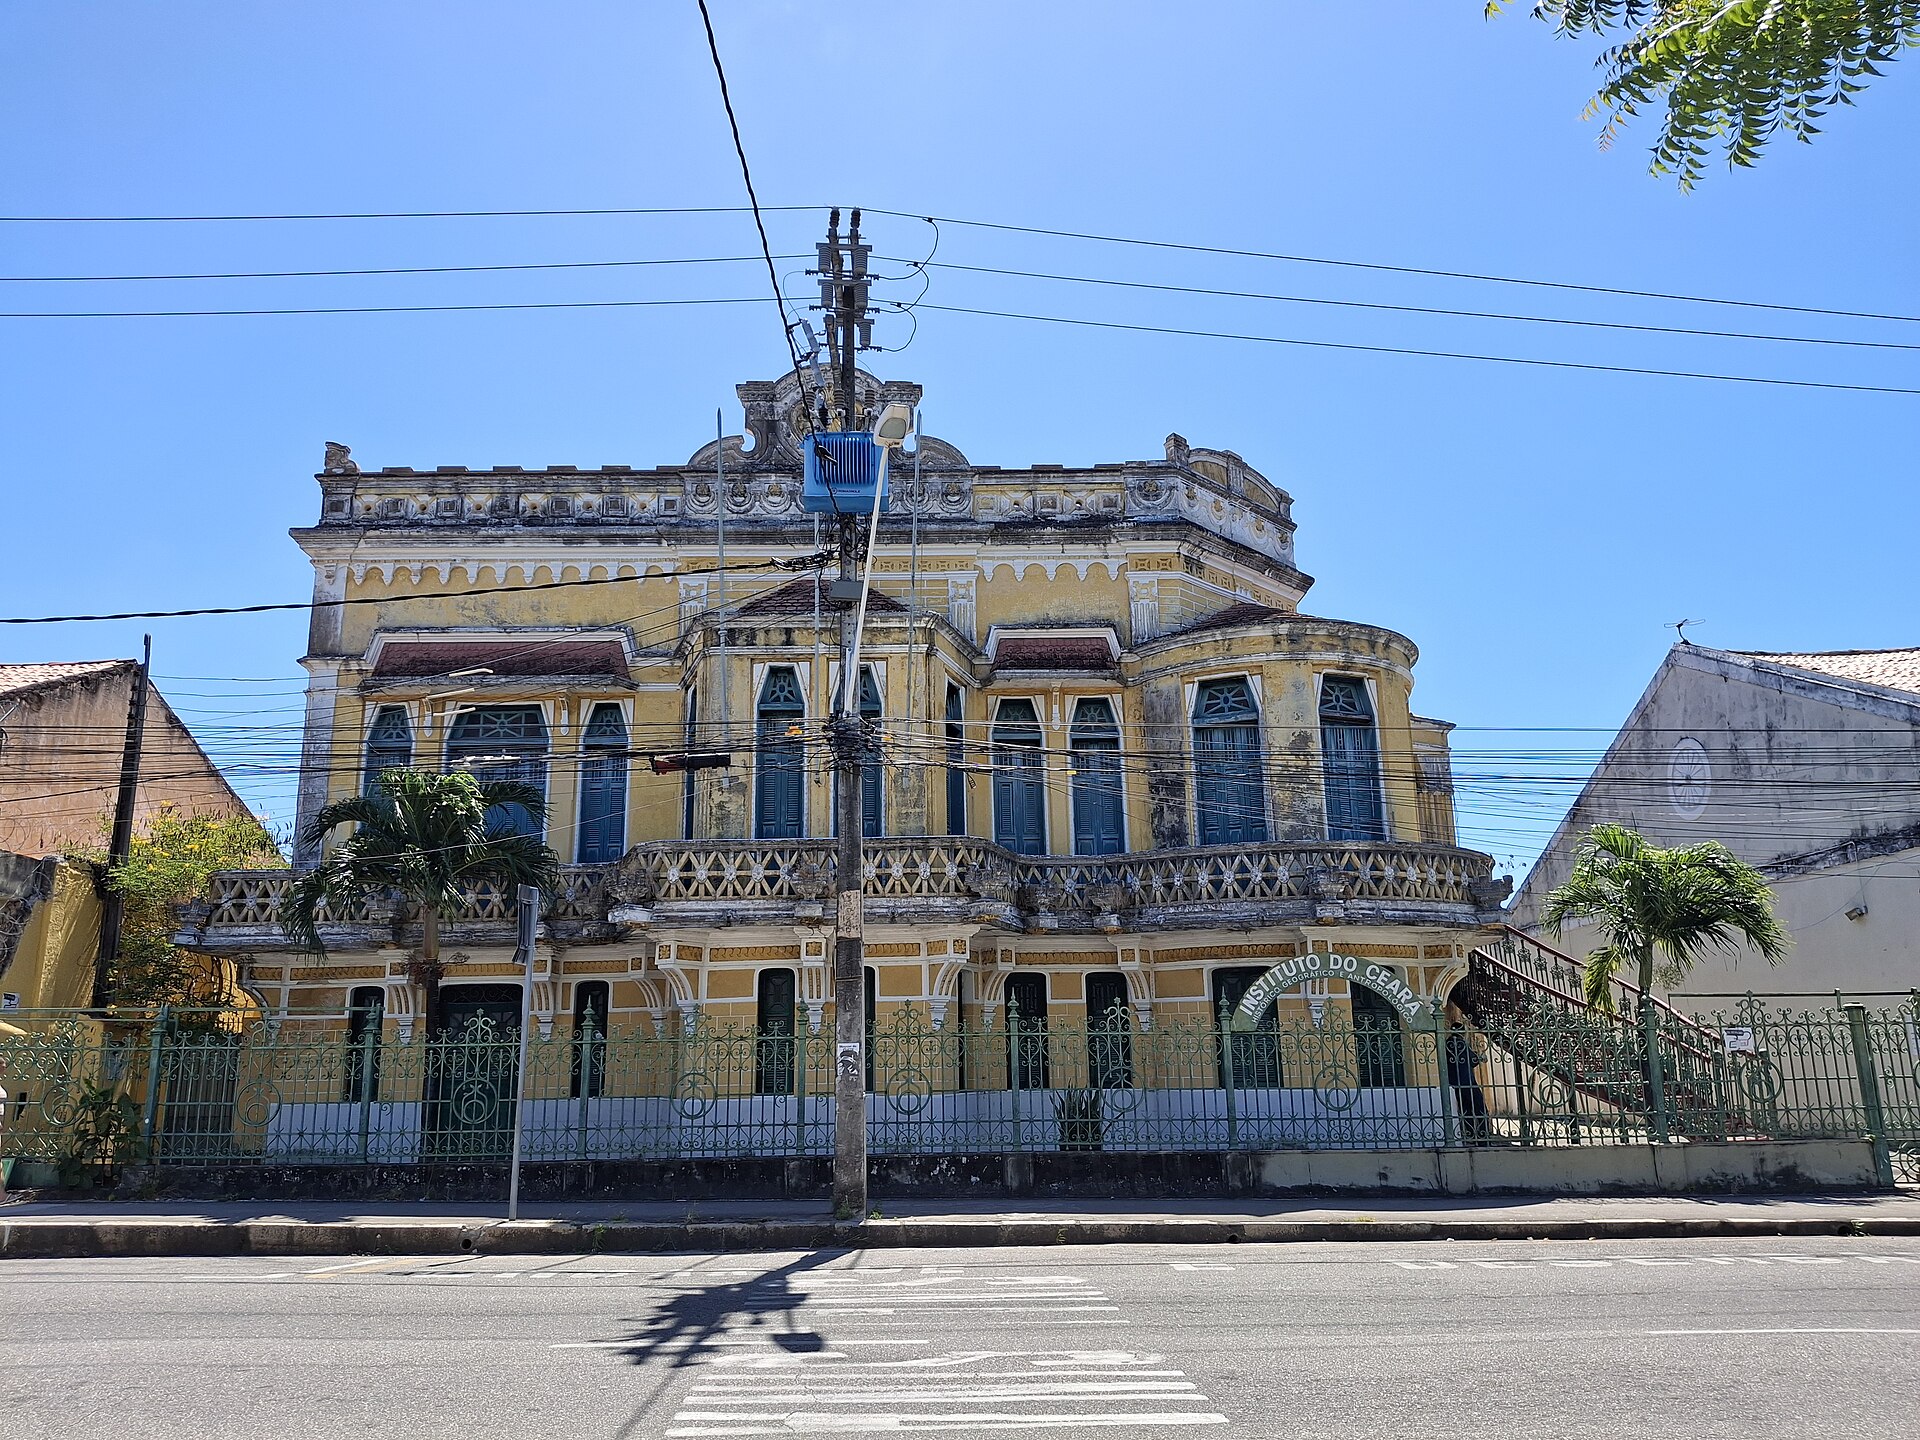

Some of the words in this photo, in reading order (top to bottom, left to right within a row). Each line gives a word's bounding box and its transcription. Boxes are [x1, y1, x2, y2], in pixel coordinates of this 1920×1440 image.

[1240, 954, 1321, 1016] INSTITUTO
[1329, 954, 1358, 972] DO
[1366, 965, 1424, 1016] CEARÁ
